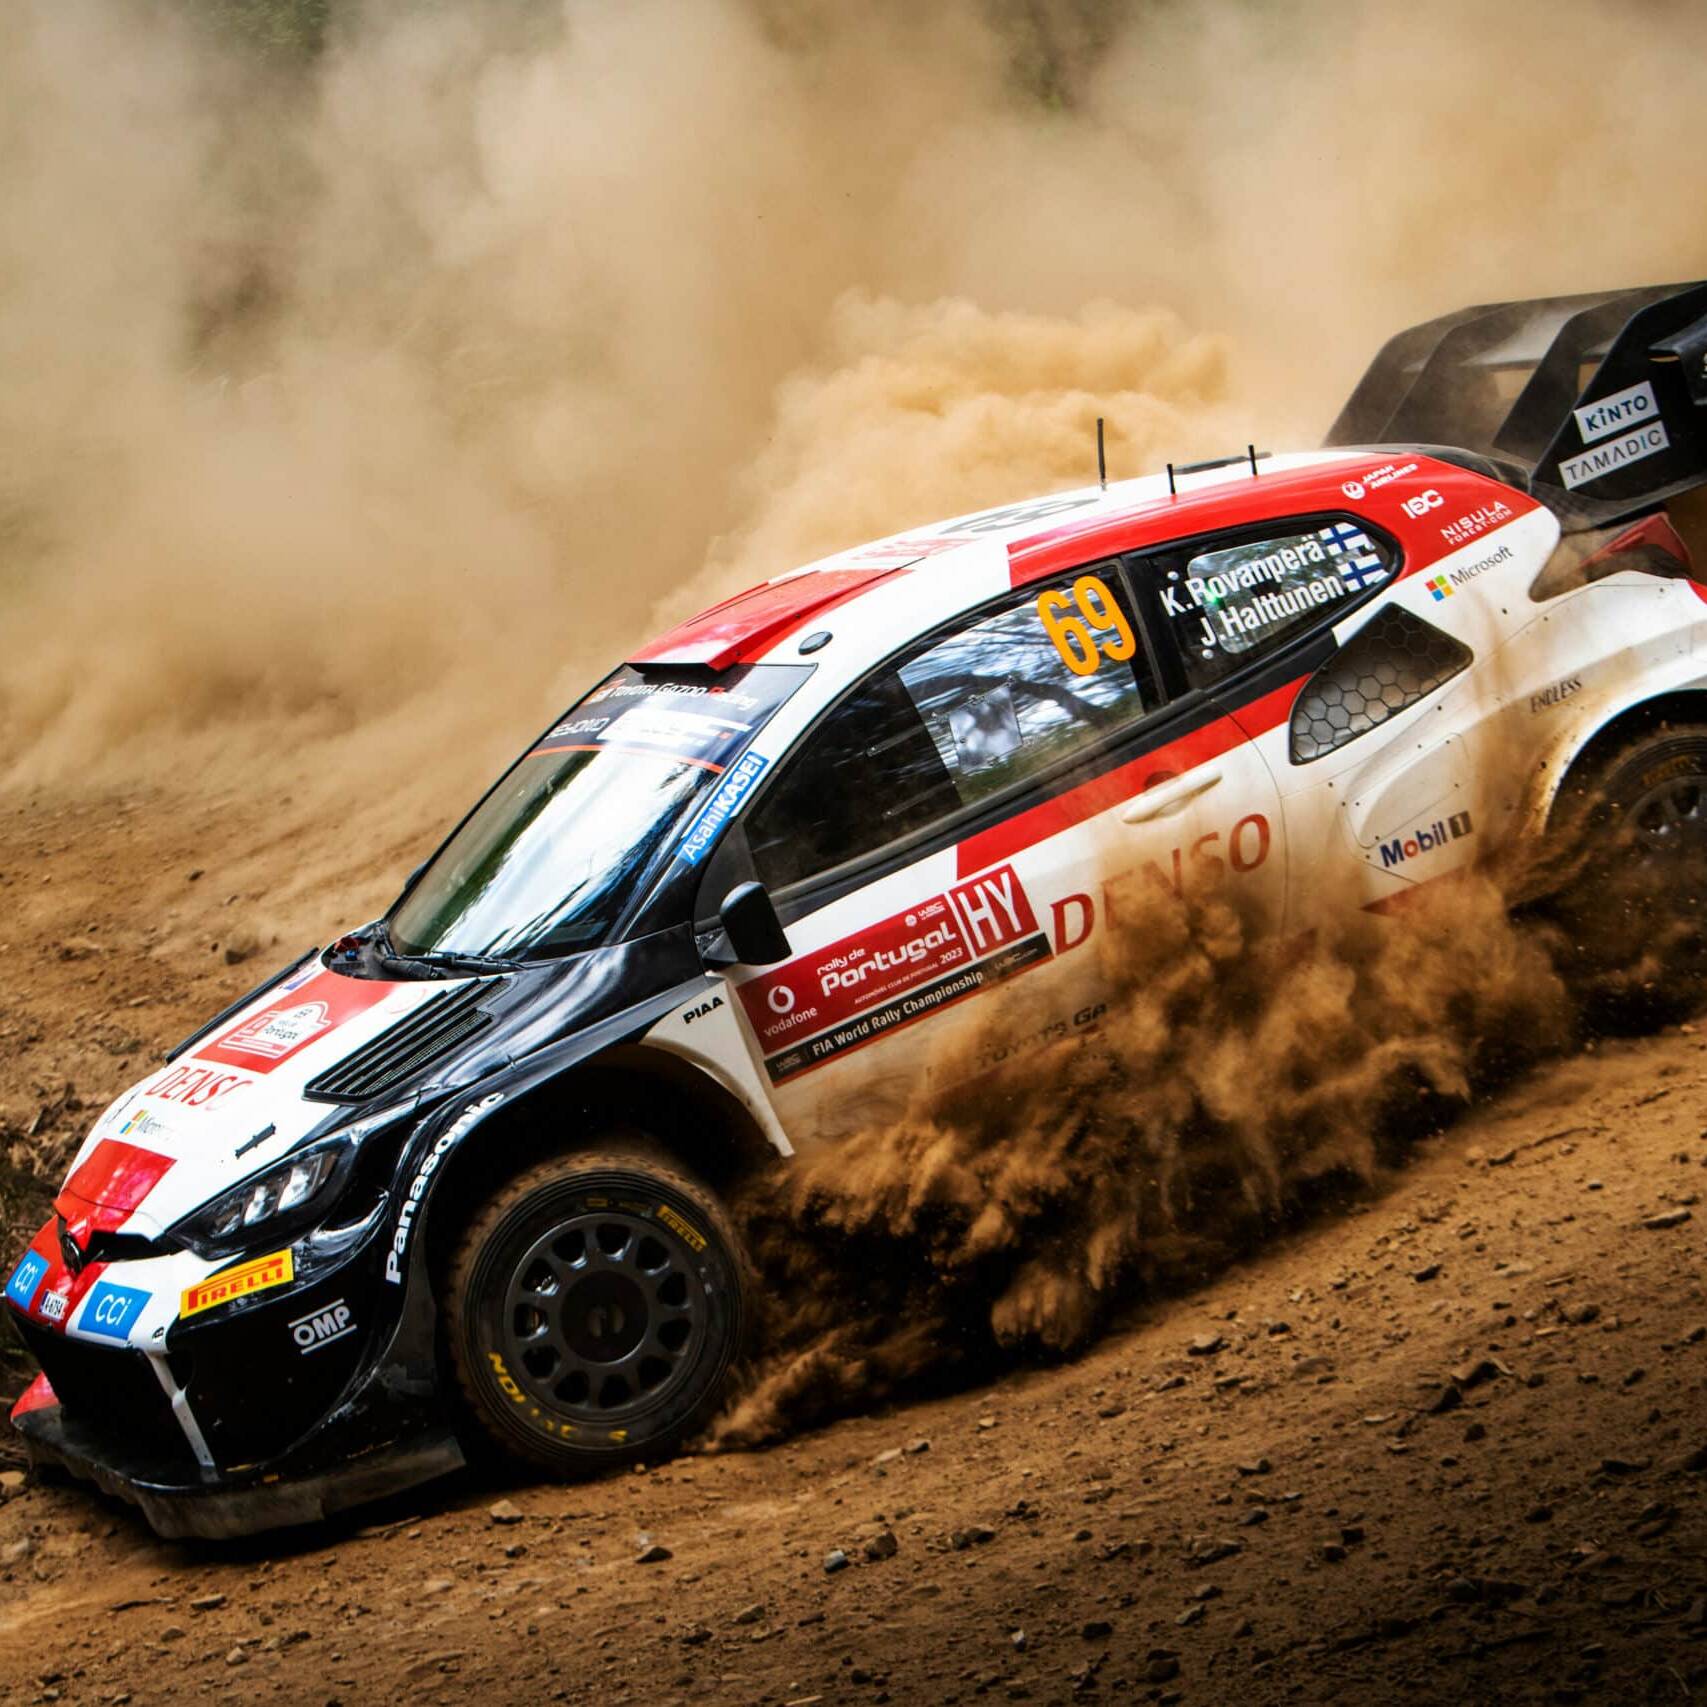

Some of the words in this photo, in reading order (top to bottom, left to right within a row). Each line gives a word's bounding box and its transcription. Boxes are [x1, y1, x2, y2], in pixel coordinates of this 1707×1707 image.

[1586, 395, 1649, 432] KINTO
[1362, 465, 1395, 484] JAPAN
[1566, 428, 1663, 481] TAMADIC
[1371, 463, 1418, 489] AIRLINES
[1440, 501, 1509, 540] NISULA
[1450, 545, 1514, 586] Microsoft
[1037, 575, 1136, 676] 69
[1530, 677, 1582, 714] ENDLESS
[682, 752, 765, 861] AsahiKASEI
[1380, 820, 1449, 868] Mobil
[957, 872, 1022, 949] HY
[816, 955, 848, 976] rally
[848, 948, 866, 961] de
[940, 947, 963, 965] 2023
[683, 997, 724, 1024] PIAA
[764, 1006, 818, 1037] vodafone
[812, 1039, 835, 1057] FIA
[835, 1021, 870, 1045] World
[871, 1007, 901, 1031] Rally
[903, 969, 984, 1016] Championship
[386, 1091, 505, 1285] Panasonic
[188, 1257, 283, 1311] PIRELLI
[293, 1305, 350, 1346] OMP
